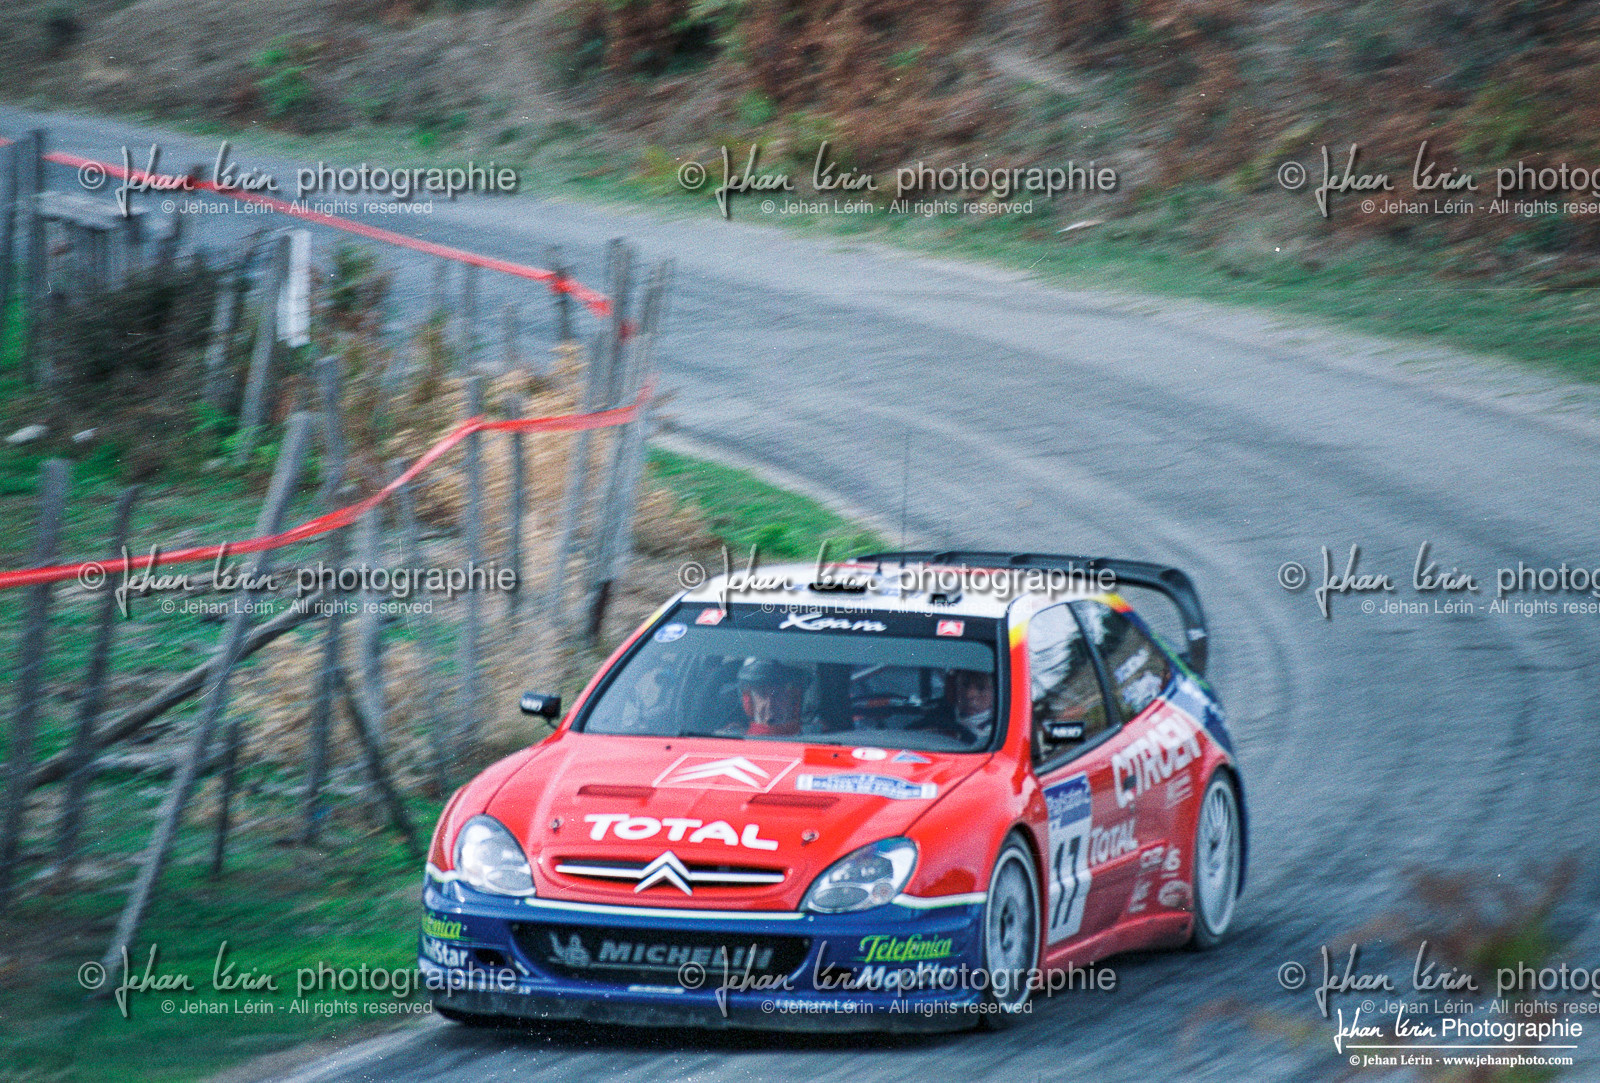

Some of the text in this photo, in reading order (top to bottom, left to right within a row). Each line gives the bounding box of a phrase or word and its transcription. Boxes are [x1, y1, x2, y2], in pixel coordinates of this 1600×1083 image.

[584, 813, 779, 851] TOTAL
[1090, 818, 1138, 866] TOTAL
[600, 940, 775, 969] MICHELIN
